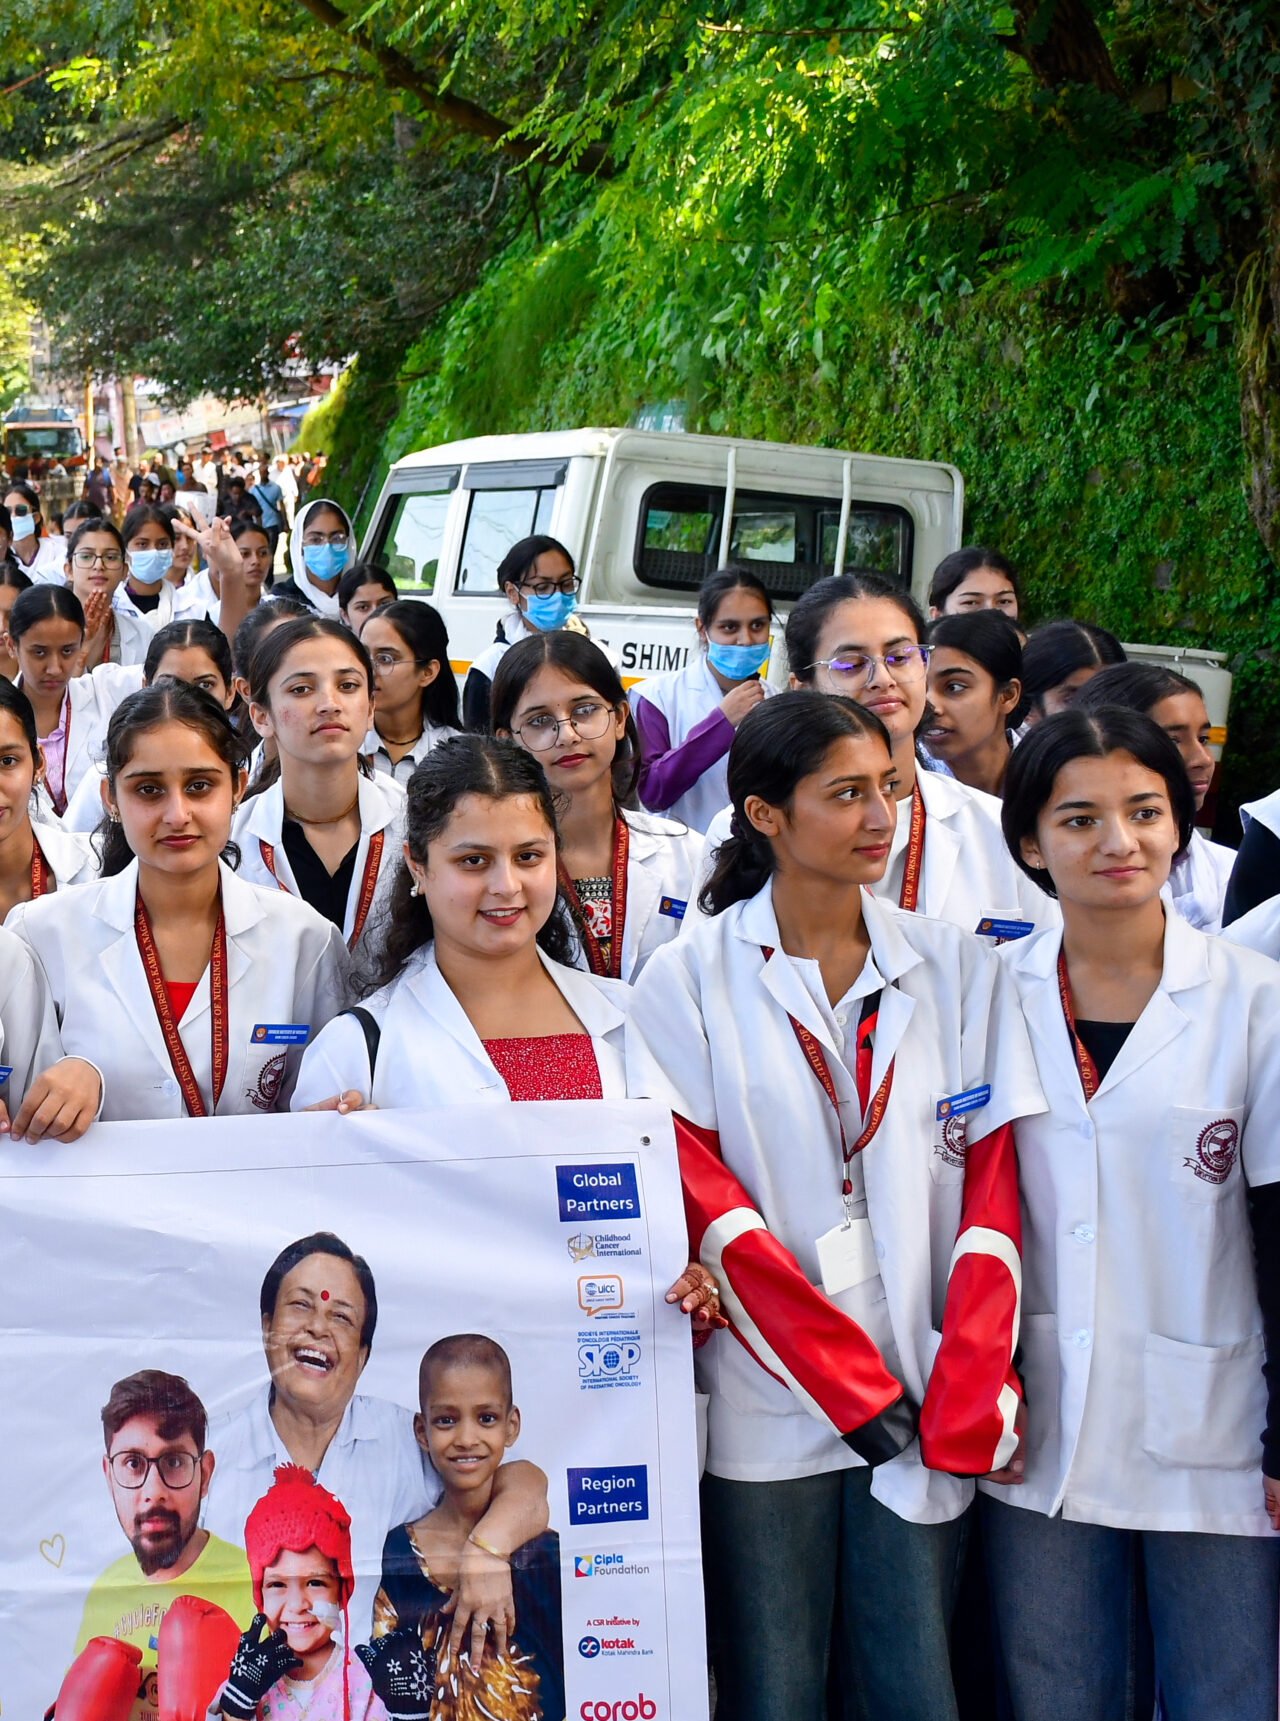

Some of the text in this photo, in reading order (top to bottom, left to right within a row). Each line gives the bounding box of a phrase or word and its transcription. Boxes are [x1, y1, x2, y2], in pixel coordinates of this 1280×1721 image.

[910, 813, 920, 842] KAMLA
[617, 836, 625, 863] KAMLA
[368, 843, 381, 877] NURSING
[906, 844, 917, 881] NURSING
[366, 878, 374, 889] OF
[615, 865, 624, 900] NURSING
[905, 882, 913, 894] OF
[614, 901, 622, 913] OF
[143, 943, 159, 976] KAMLA
[212, 960, 222, 1000] NURSING
[152, 977, 169, 1016] NURSING
[213, 1002, 221, 1015] OF
[162, 1017, 172, 1031] OF
[213, 1017, 223, 1068] INSTITUTE
[167, 1031, 192, 1081] INSTITUTE
[798, 1026, 832, 1092] INSTITUTE OF
[1080, 1064, 1092, 1080] OF
[573, 1172, 621, 1187] Global
[567, 1199, 633, 1212] Partners
[595, 1233, 631, 1242] Childhood
[597, 1248, 642, 1256] International
[578, 1343, 641, 1377] SIOP
[582, 1475, 635, 1493] Region
[577, 1501, 642, 1515] Partners
[594, 1553, 623, 1565] Cipla
[594, 1565, 649, 1576] Foundation
[632, 1618, 640, 1626] by
[601, 1638, 635, 1649] kotak
[580, 1693, 656, 1721] corob
